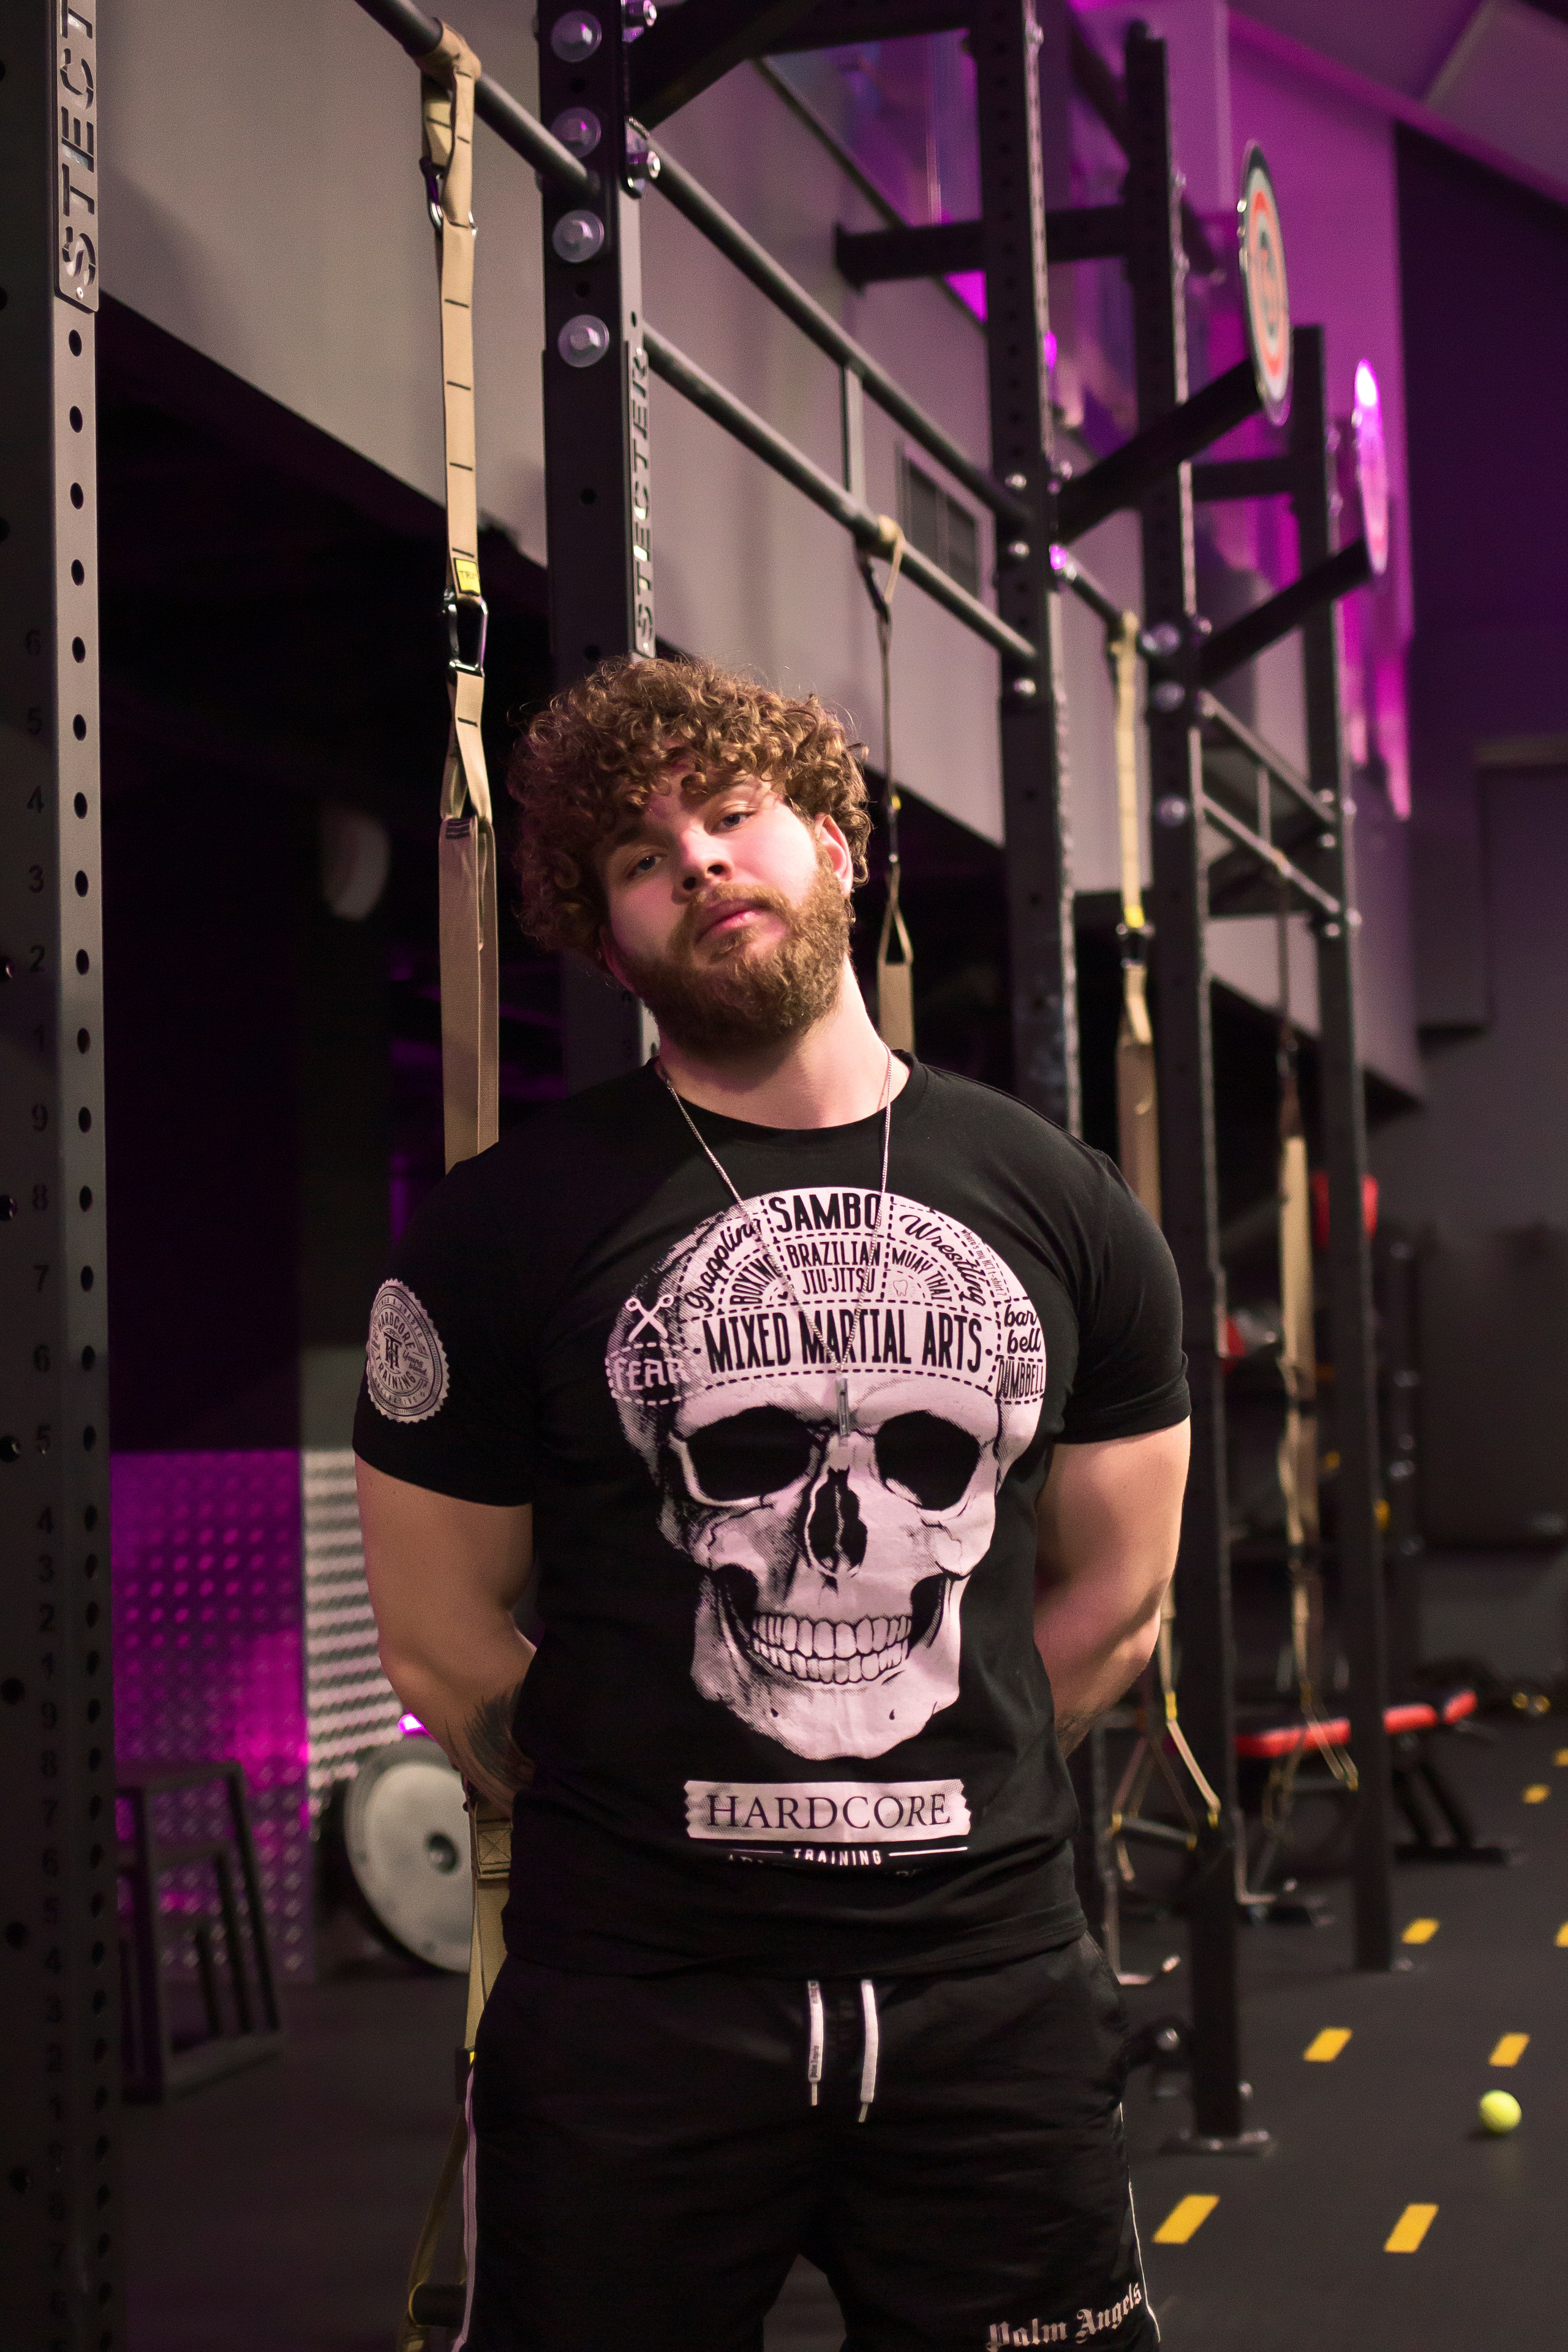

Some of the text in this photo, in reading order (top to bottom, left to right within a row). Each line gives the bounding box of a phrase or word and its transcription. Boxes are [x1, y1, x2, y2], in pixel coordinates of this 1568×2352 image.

[633, 354, 653, 638] STECTER
[769, 1193, 882, 1232] SAMBO
[786, 1241, 881, 1268] BRAZILIAN
[899, 1215, 986, 1306] Wrestling
[892, 1248, 952, 1302] MUAY THAI
[377, 1311, 415, 1349] HARDCORE
[1004, 1304, 1038, 1327] bar
[702, 1309, 982, 1374] MIXED MARTIAL ARTS
[1007, 1328, 1041, 1354] bell
[375, 1353, 416, 1390] TRAINING
[996, 1359, 1043, 1398] DUMBBELL
[706, 1793, 951, 1830] HARDCORE
[793, 1849, 881, 1866] TRAINING
[986, 2282, 1142, 2352] Palm Angels
